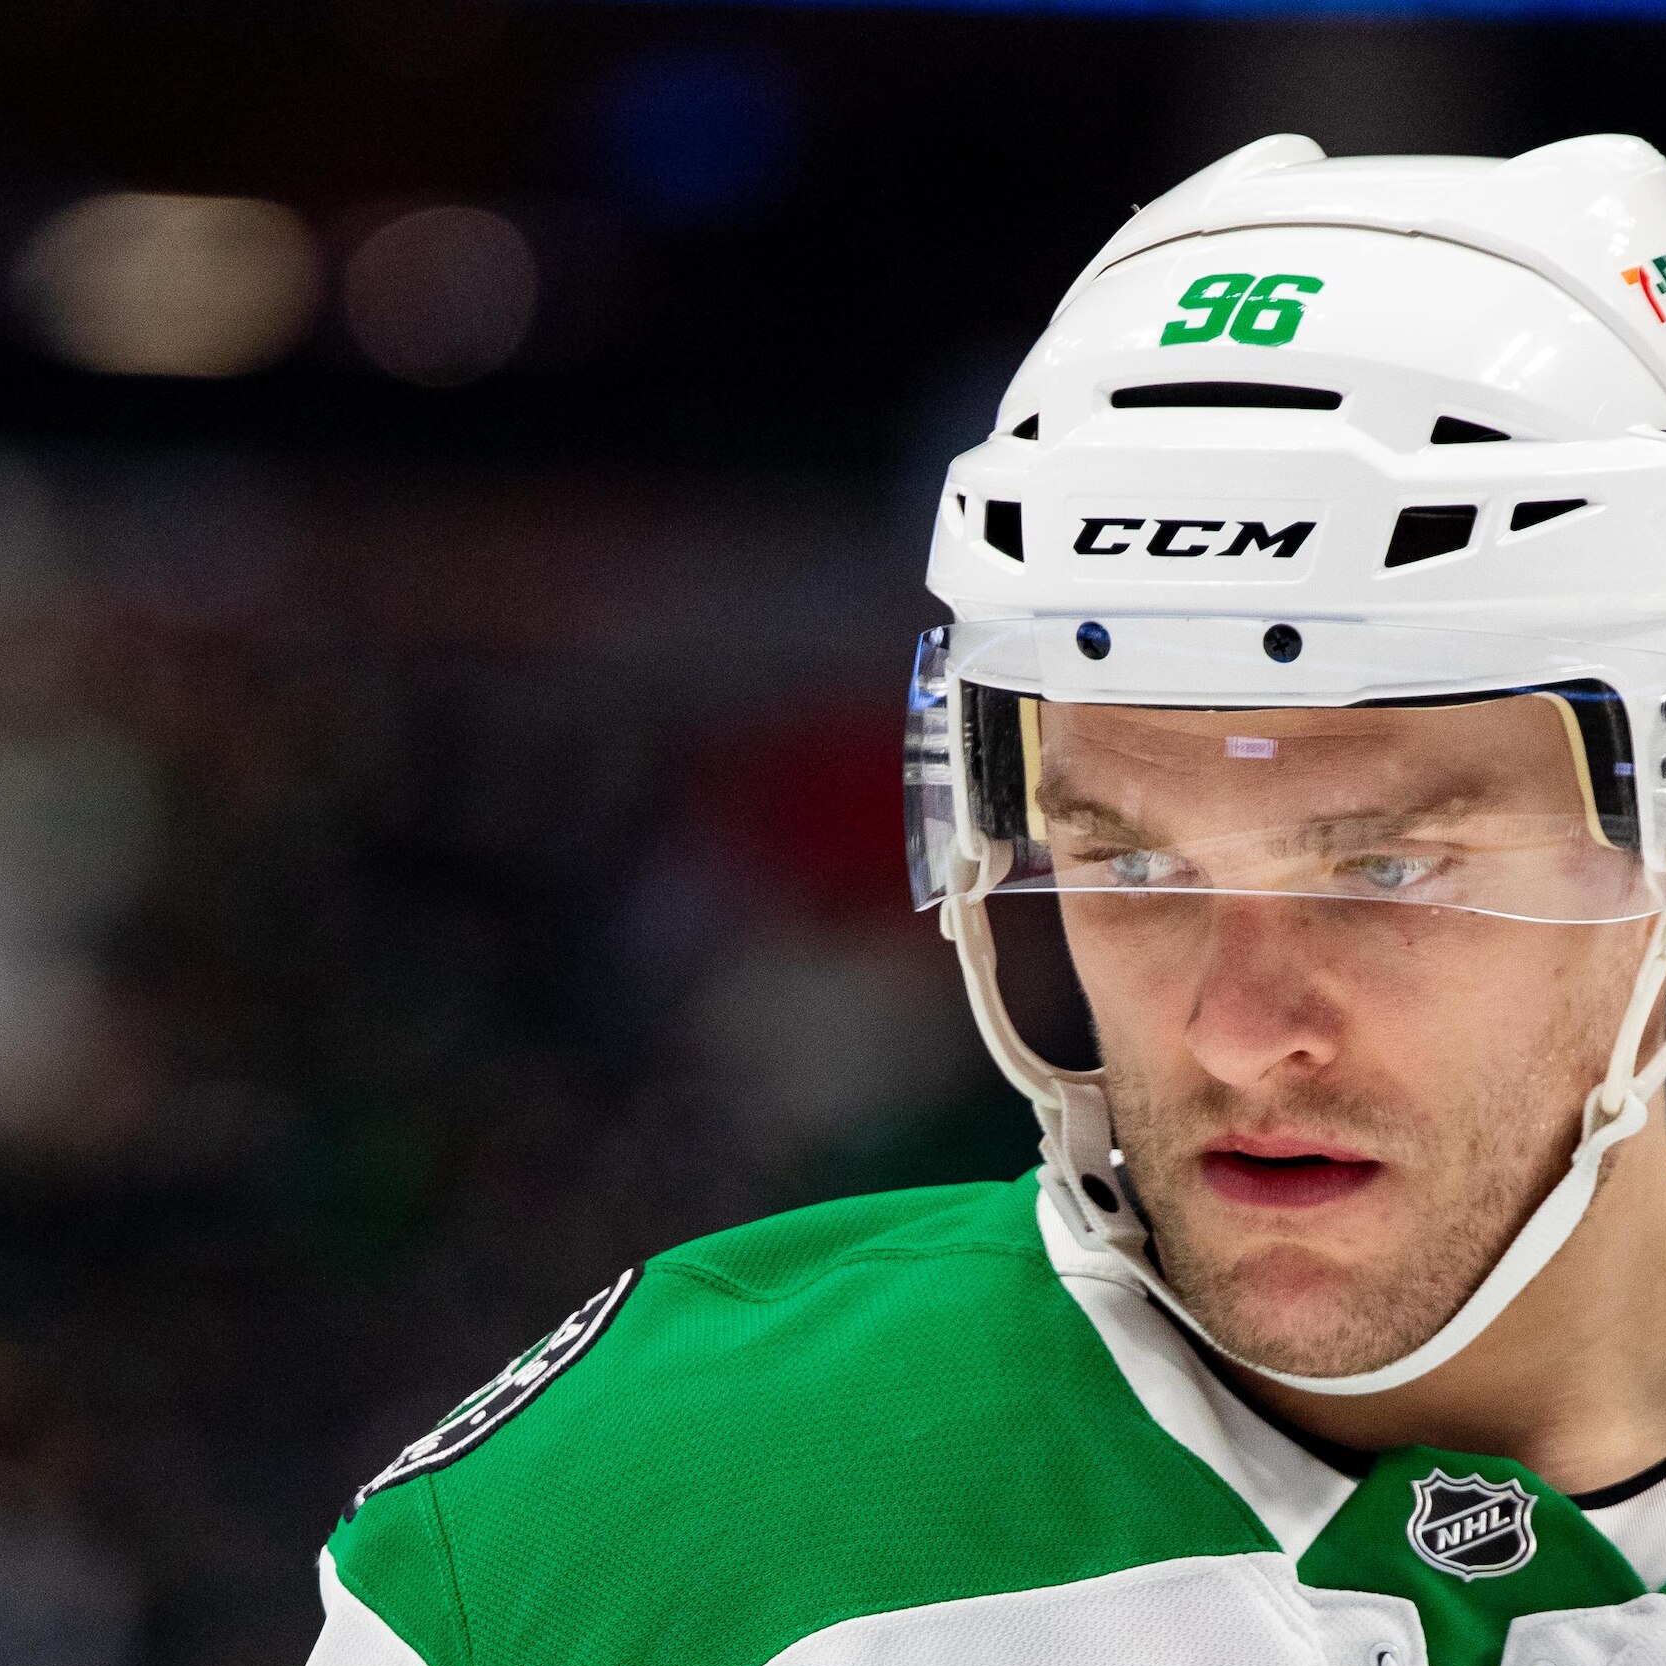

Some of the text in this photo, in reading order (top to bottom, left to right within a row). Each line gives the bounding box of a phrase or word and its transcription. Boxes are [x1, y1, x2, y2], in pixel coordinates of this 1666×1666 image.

[1159, 272, 1325, 347] 96
[1073, 517, 1317, 558] CCM
[1435, 1505, 1511, 1551] NHL
